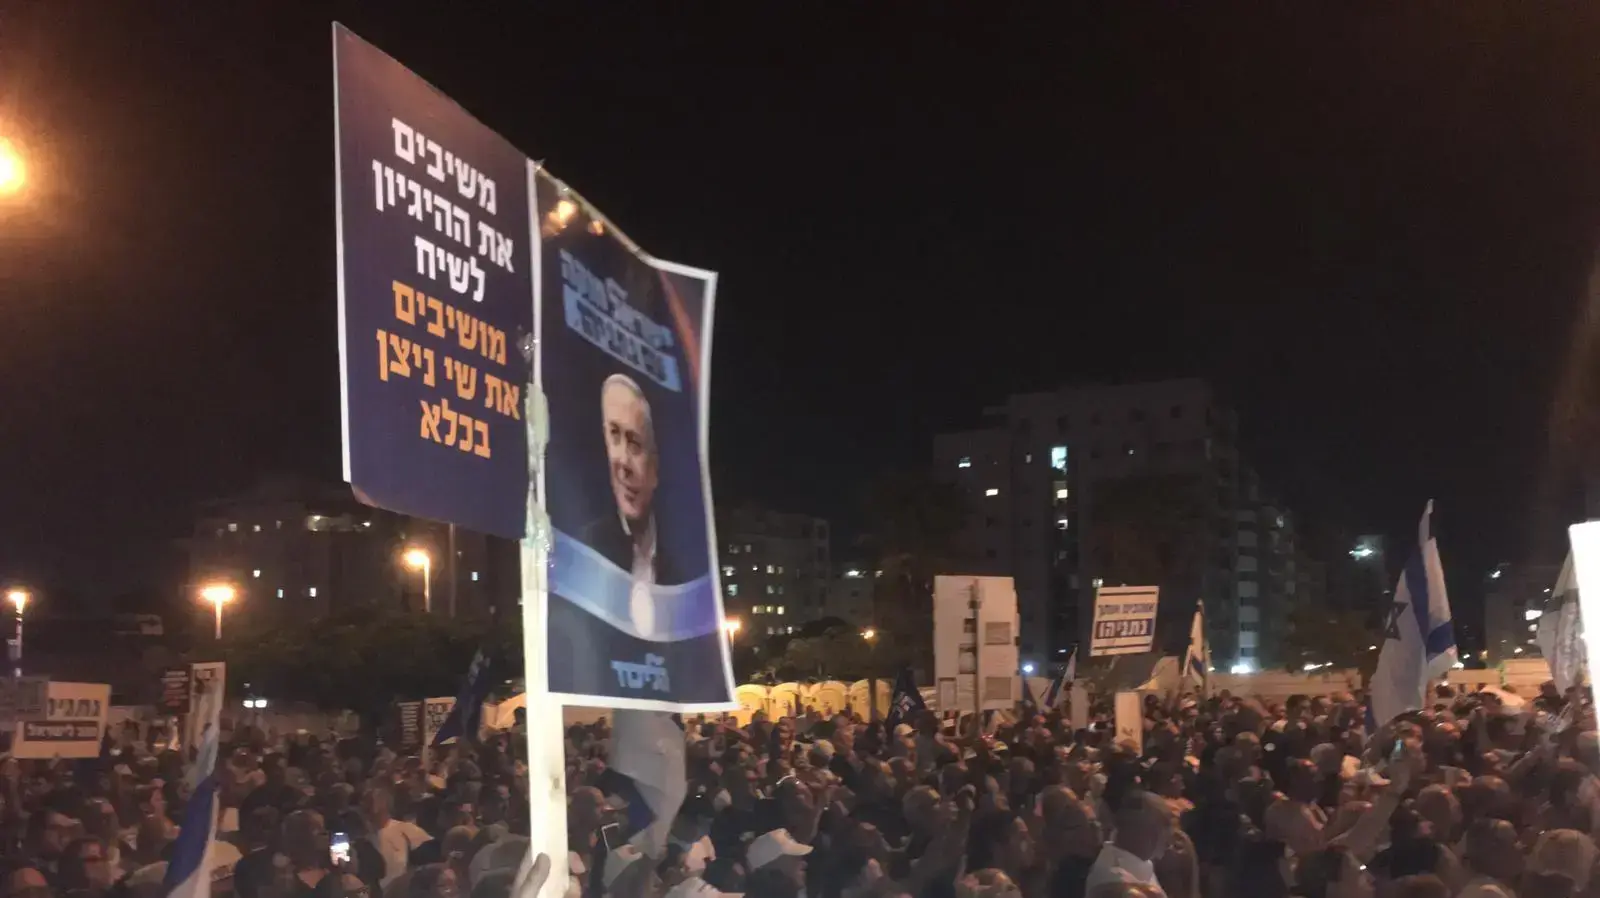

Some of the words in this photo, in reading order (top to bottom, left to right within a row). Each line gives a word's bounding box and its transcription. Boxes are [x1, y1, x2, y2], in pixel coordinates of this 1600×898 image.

[392, 117, 497, 215] משיבים
[372, 159, 471, 248] ההיגיון
[415, 235, 486, 302] לשיח
[478, 220, 515, 273] את
[392, 280, 507, 366] מושיבים
[376, 328, 435, 388] ניצן
[444, 356, 477, 401] שי
[484, 373, 521, 420] את
[420, 398, 491, 459] בכלא
[1099, 620, 1149, 637] נתניהו
